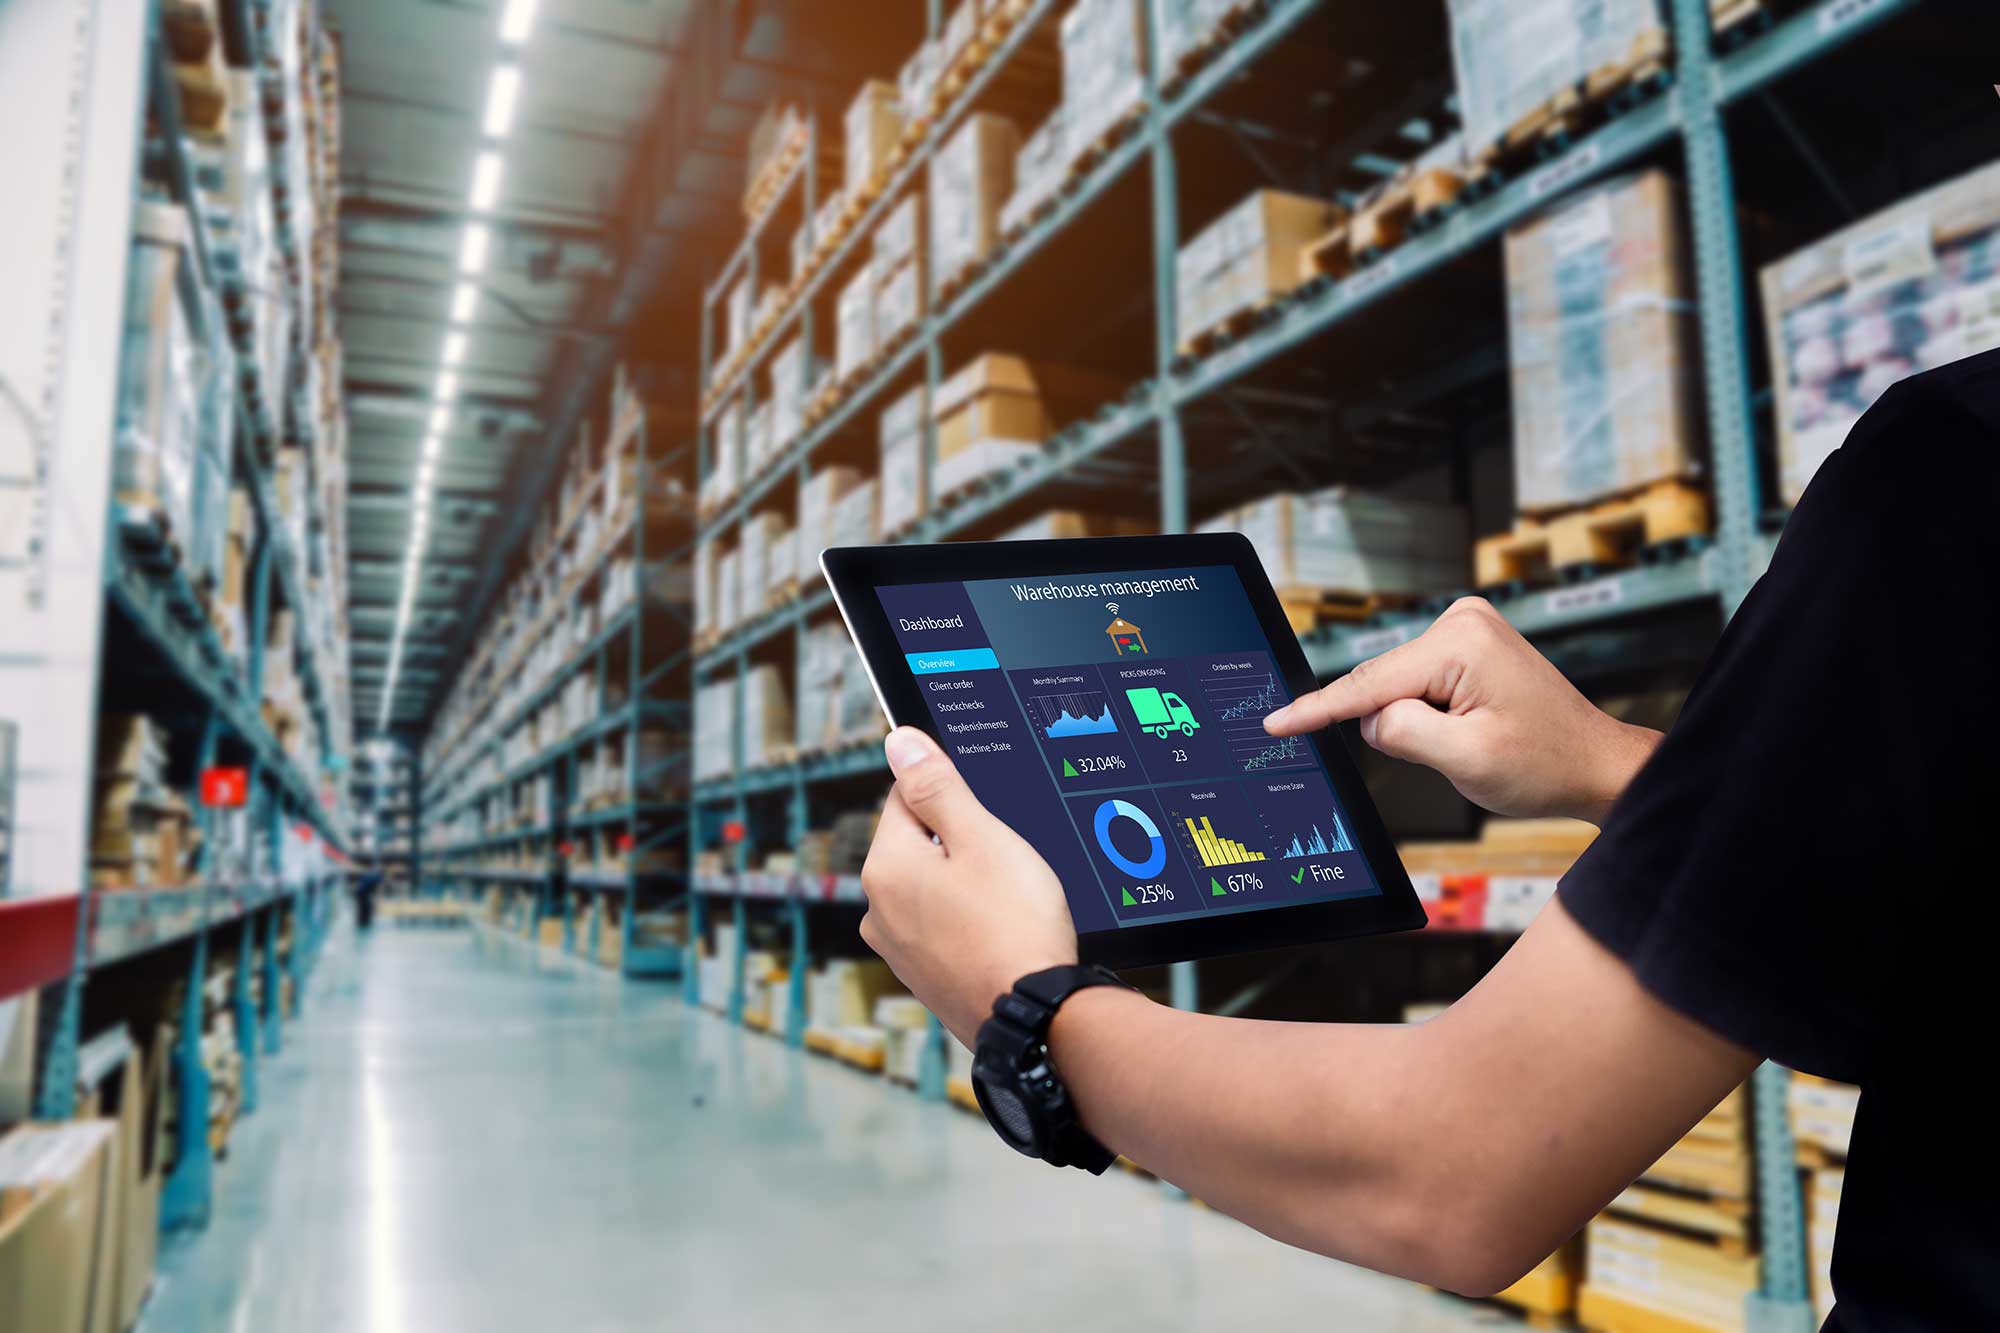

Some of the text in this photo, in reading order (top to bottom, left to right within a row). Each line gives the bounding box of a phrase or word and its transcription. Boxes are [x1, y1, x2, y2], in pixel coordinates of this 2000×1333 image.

[1010, 575, 1200, 601] Warehouse management
[899, 614, 964, 632] Dashboard
[918, 658, 956, 670] Overview
[1211, 661, 1253, 672] Orders by week
[1032, 674, 1084, 686] Monthly Summary
[1120, 670, 1137, 679] PICKS
[953, 680, 974, 689] order
[937, 700, 985, 712] Stockchecks
[947, 720, 1009, 733] Replenishments
[957, 742, 1012, 754] Machine State
[1172, 749, 1188, 762] 23
[1078, 755, 1126, 773] 32.04%
[1267, 782, 1305, 792] Machine State
[1309, 864, 1345, 882] Fine
[1227, 873, 1264, 893] 67%
[1136, 883, 1175, 904] 25%
